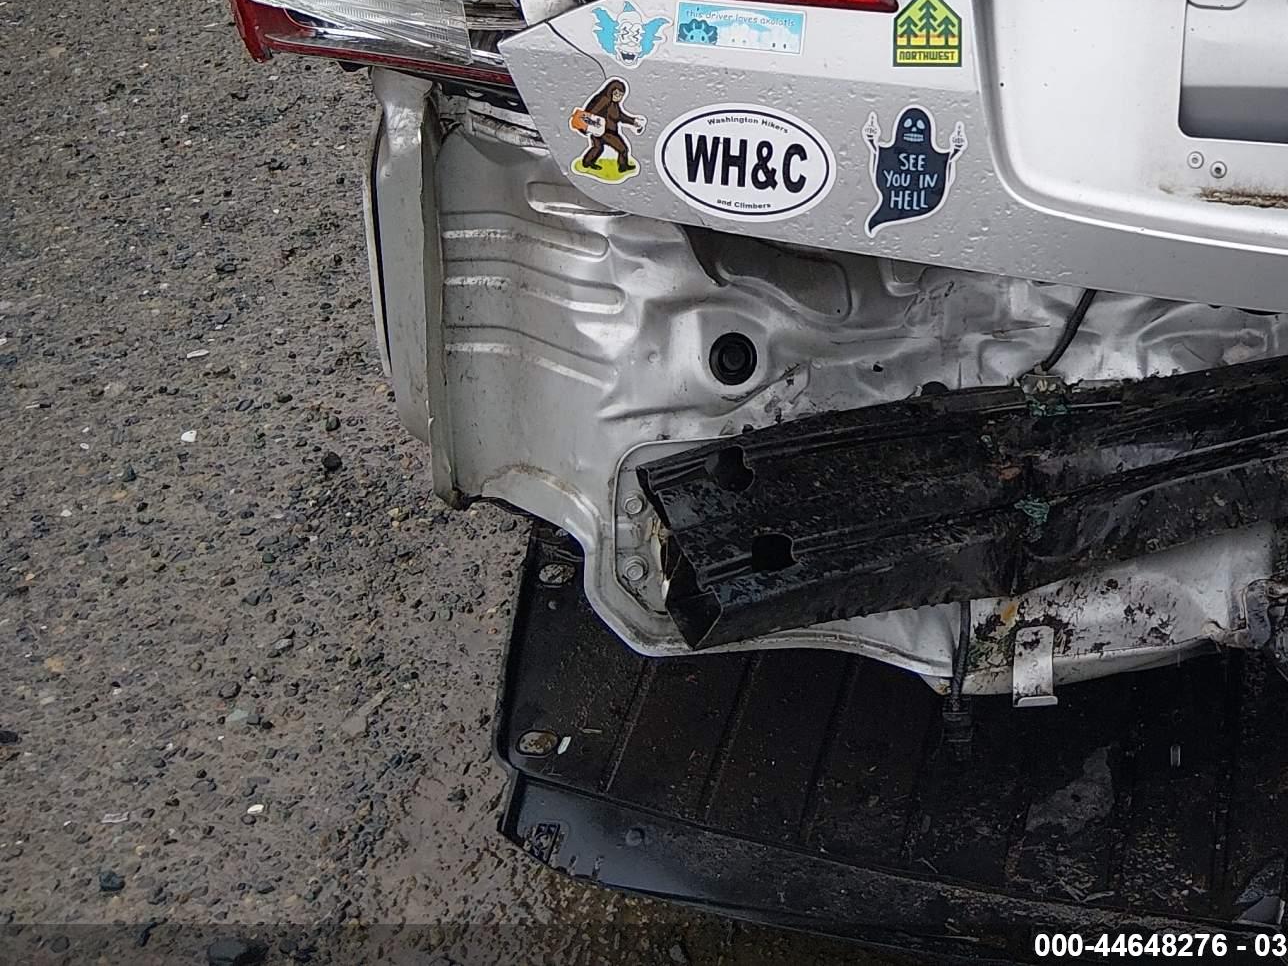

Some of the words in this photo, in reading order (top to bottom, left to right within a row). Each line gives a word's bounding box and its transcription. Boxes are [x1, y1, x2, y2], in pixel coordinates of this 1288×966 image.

[686, 9, 703, 18] this
[705, 11, 733, 21] driver
[735, 13, 758, 23] loves
[898, 50, 956, 61] NORTHWEST
[707, 115, 759, 126] Washington
[760, 118, 789, 134] Hikers
[684, 133, 808, 194] WH&C
[898, 153, 926, 171] SEE
[883, 170, 911, 188] YOU
[919, 173, 938, 189] IN
[716, 198, 732, 207] and
[733, 200, 772, 209] Climbers
[889, 190, 929, 210] HELL
